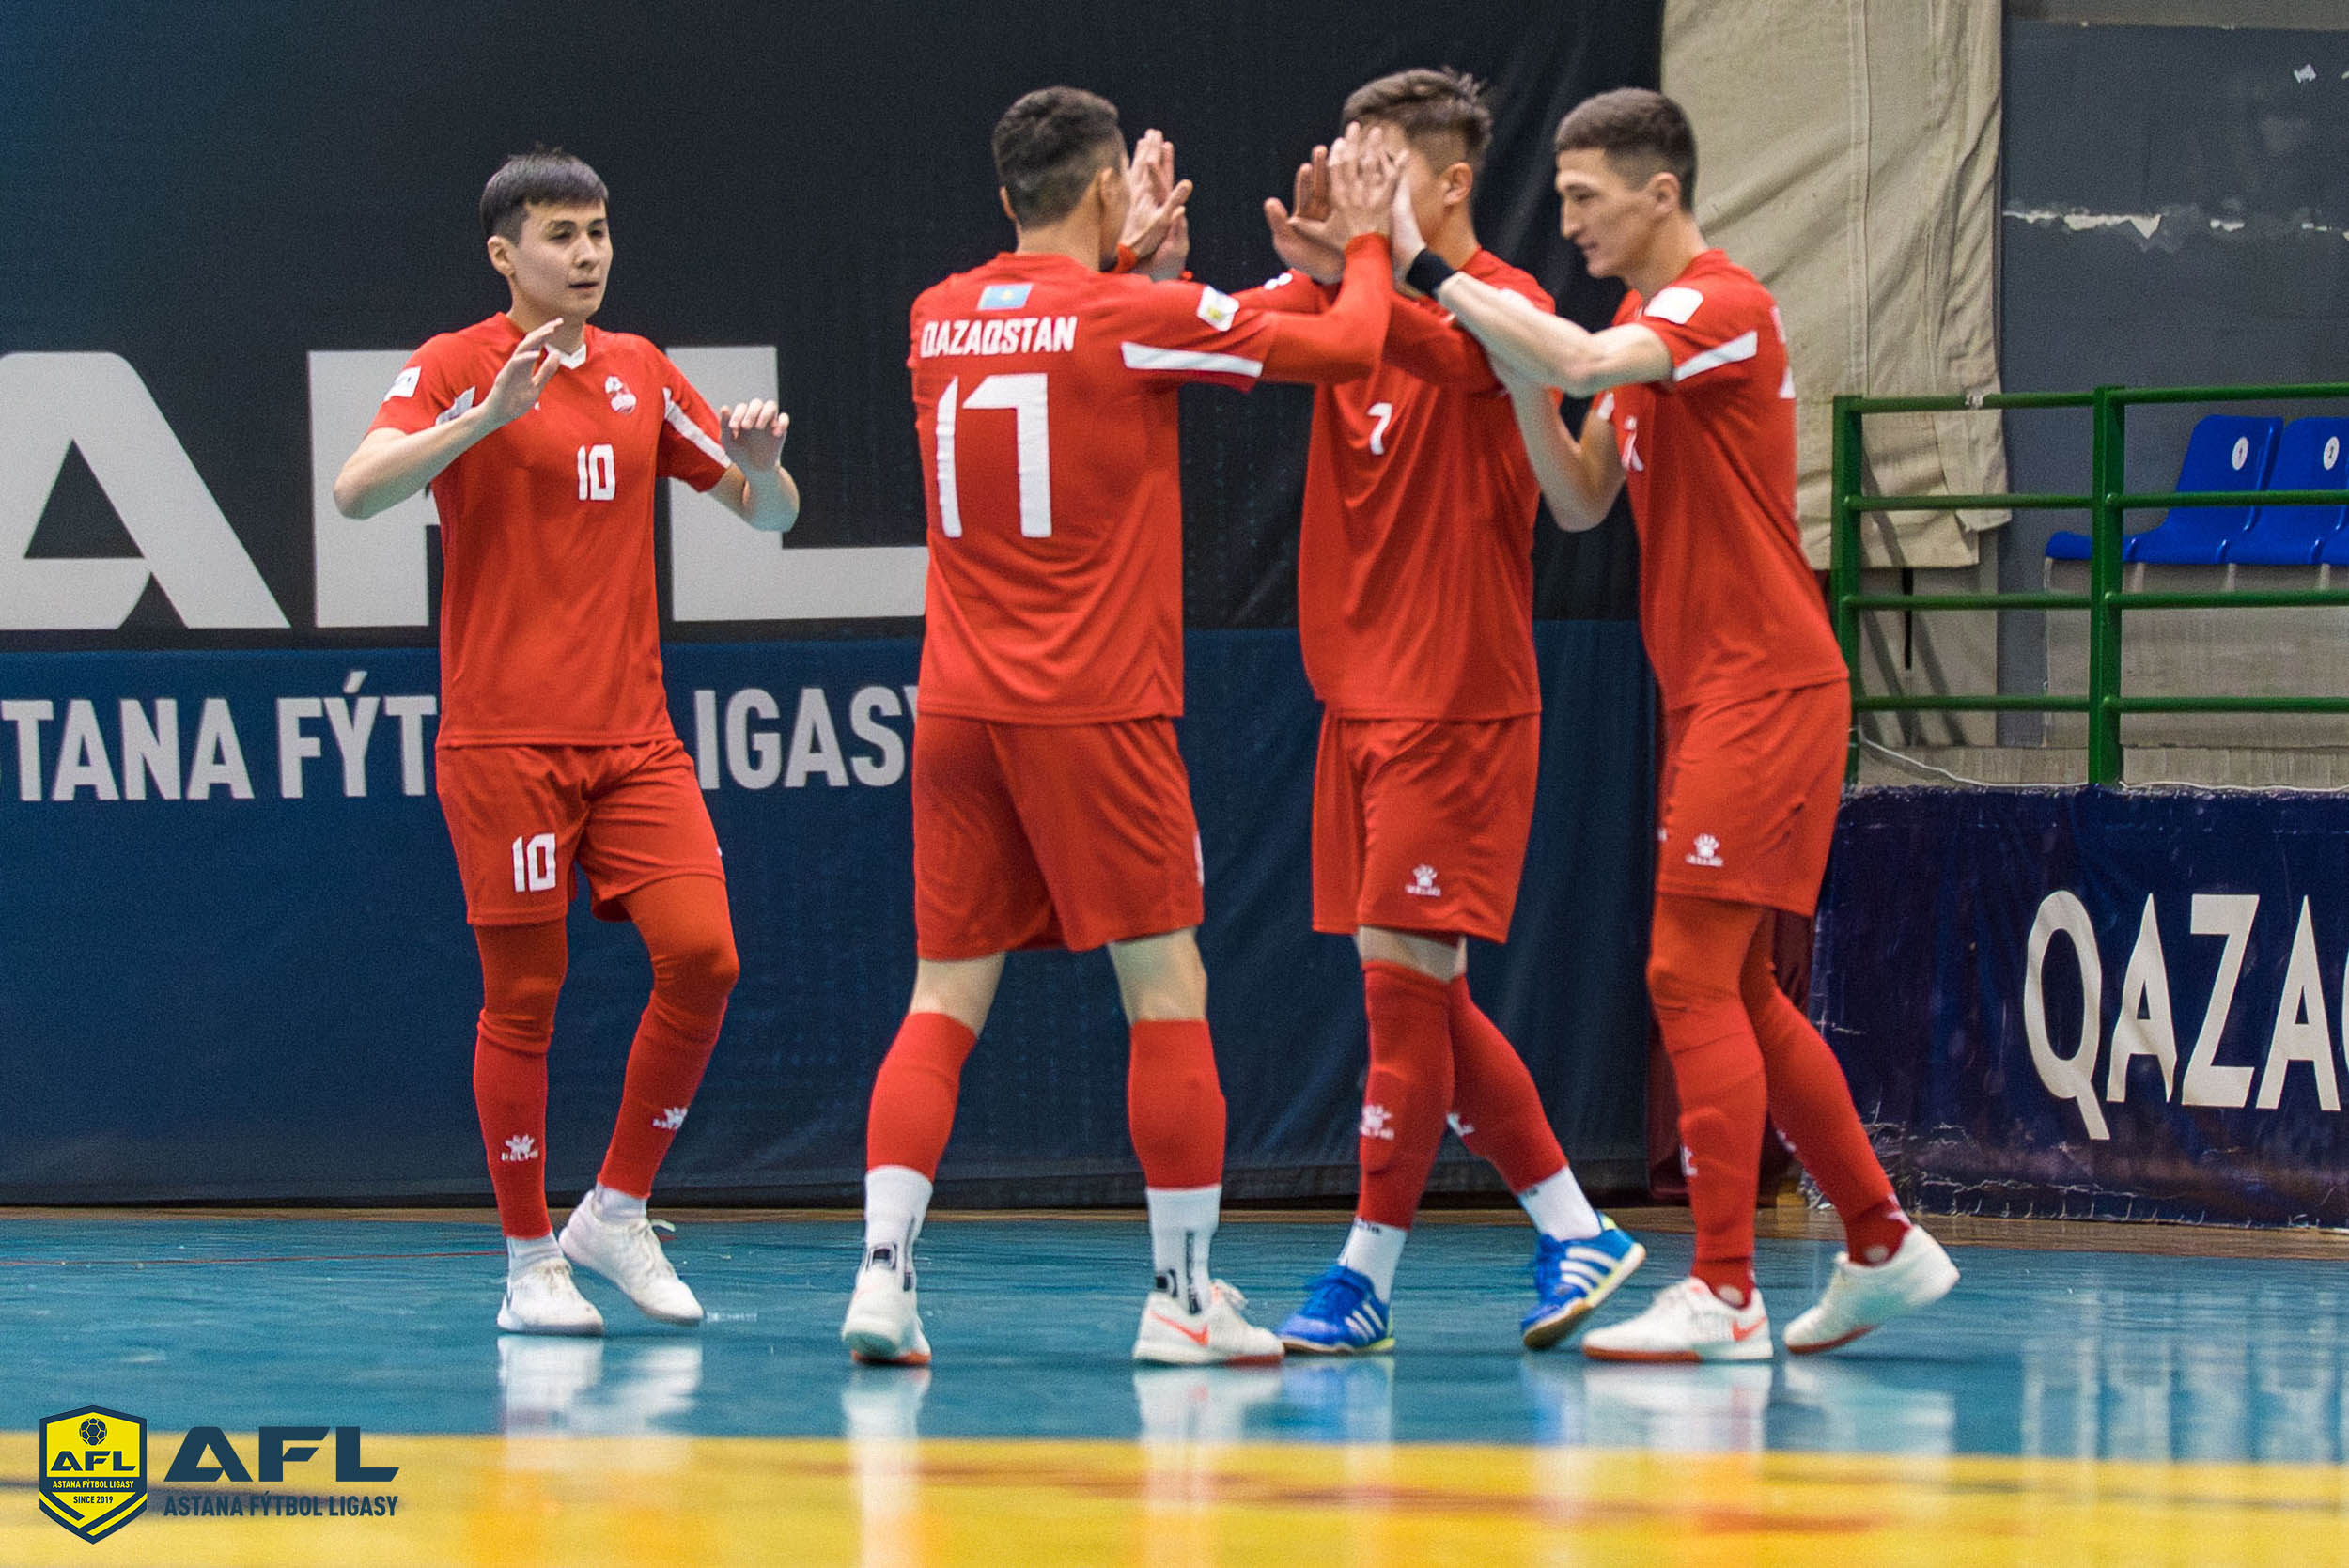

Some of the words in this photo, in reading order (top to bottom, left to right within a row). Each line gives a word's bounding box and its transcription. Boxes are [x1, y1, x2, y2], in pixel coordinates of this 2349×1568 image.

[919, 316, 1078, 358] QAZAQSTAN
[935, 372, 1052, 539] 17
[1367, 401, 1393, 456] 7
[576, 443, 616, 501] 10
[0, 696, 256, 801] TANA
[275, 670, 439, 799] FÝT
[693, 685, 920, 790] IGAS
[511, 832, 557, 893] 10
[2023, 890, 2349, 1141] QAZA
